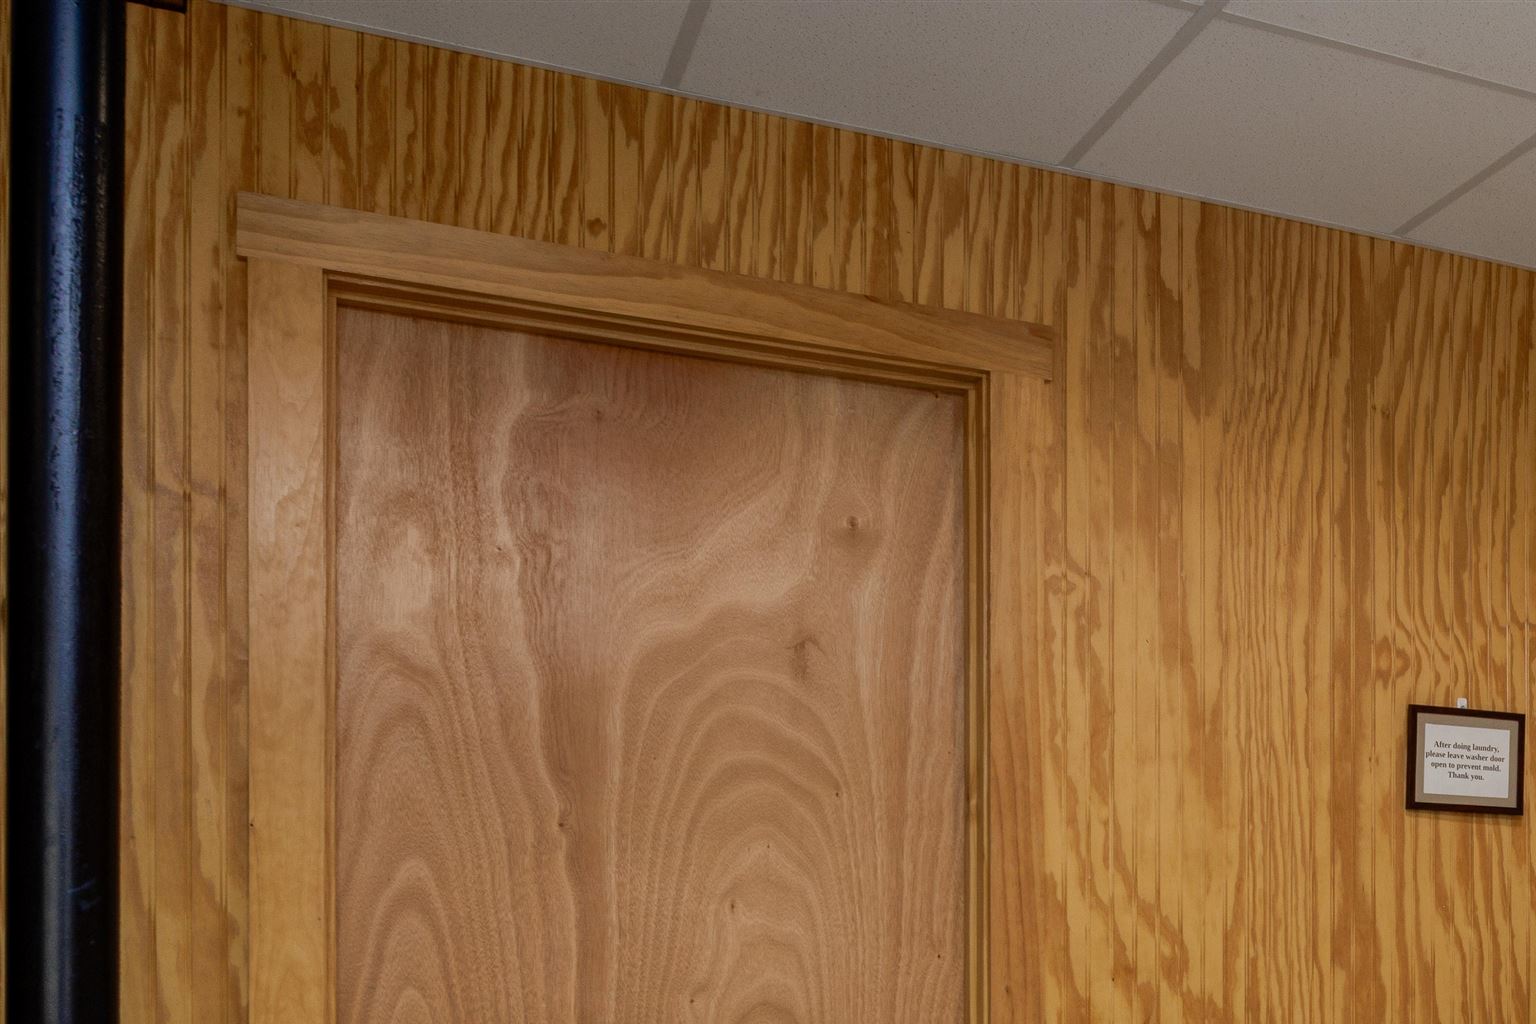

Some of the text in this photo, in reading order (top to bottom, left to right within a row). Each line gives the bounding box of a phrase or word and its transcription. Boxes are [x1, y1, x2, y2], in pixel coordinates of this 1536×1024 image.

[1434, 741, 1500, 753] After doing laundry,
[1425, 750, 1446, 759] please
[1447, 751, 1464, 759] leave
[1448, 771, 1469, 779] Thank
